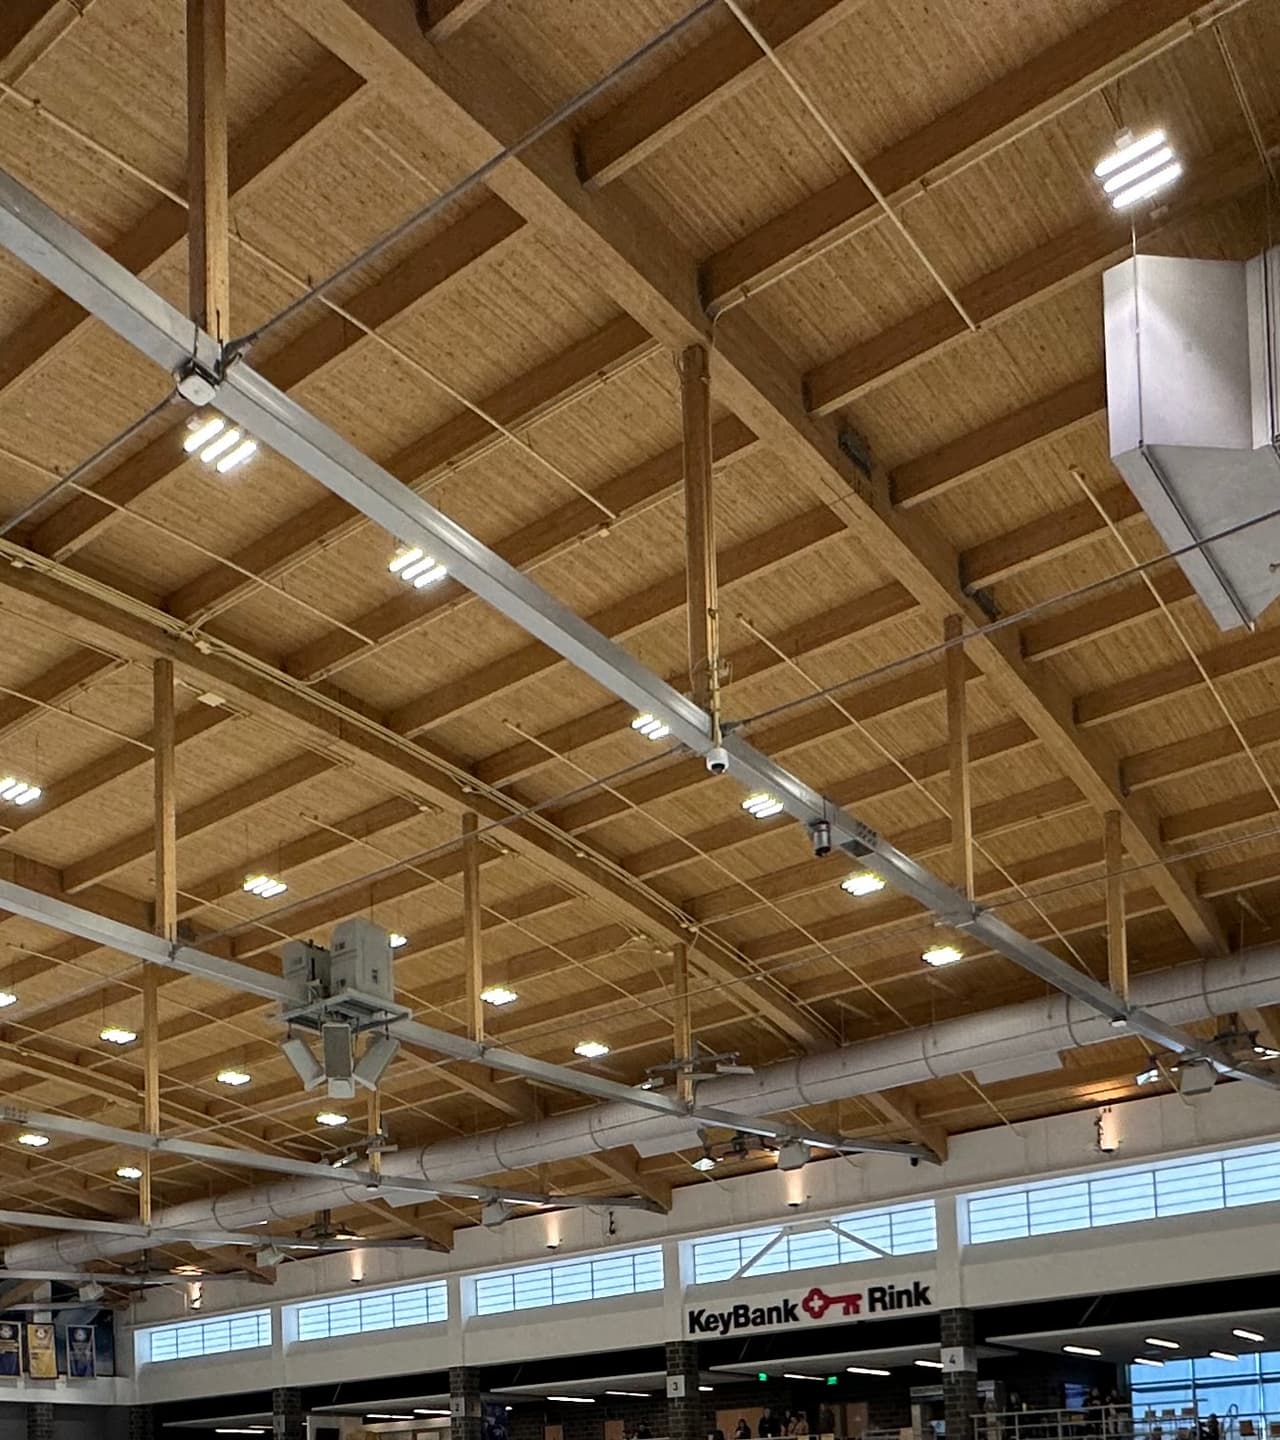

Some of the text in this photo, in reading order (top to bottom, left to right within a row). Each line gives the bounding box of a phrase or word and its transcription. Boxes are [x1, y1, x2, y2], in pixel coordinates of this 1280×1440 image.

[688, 1281, 932, 1335] KeyBank Rink
[949, 1353, 956, 1365] 4
[672, 1381, 679, 1391] 3
